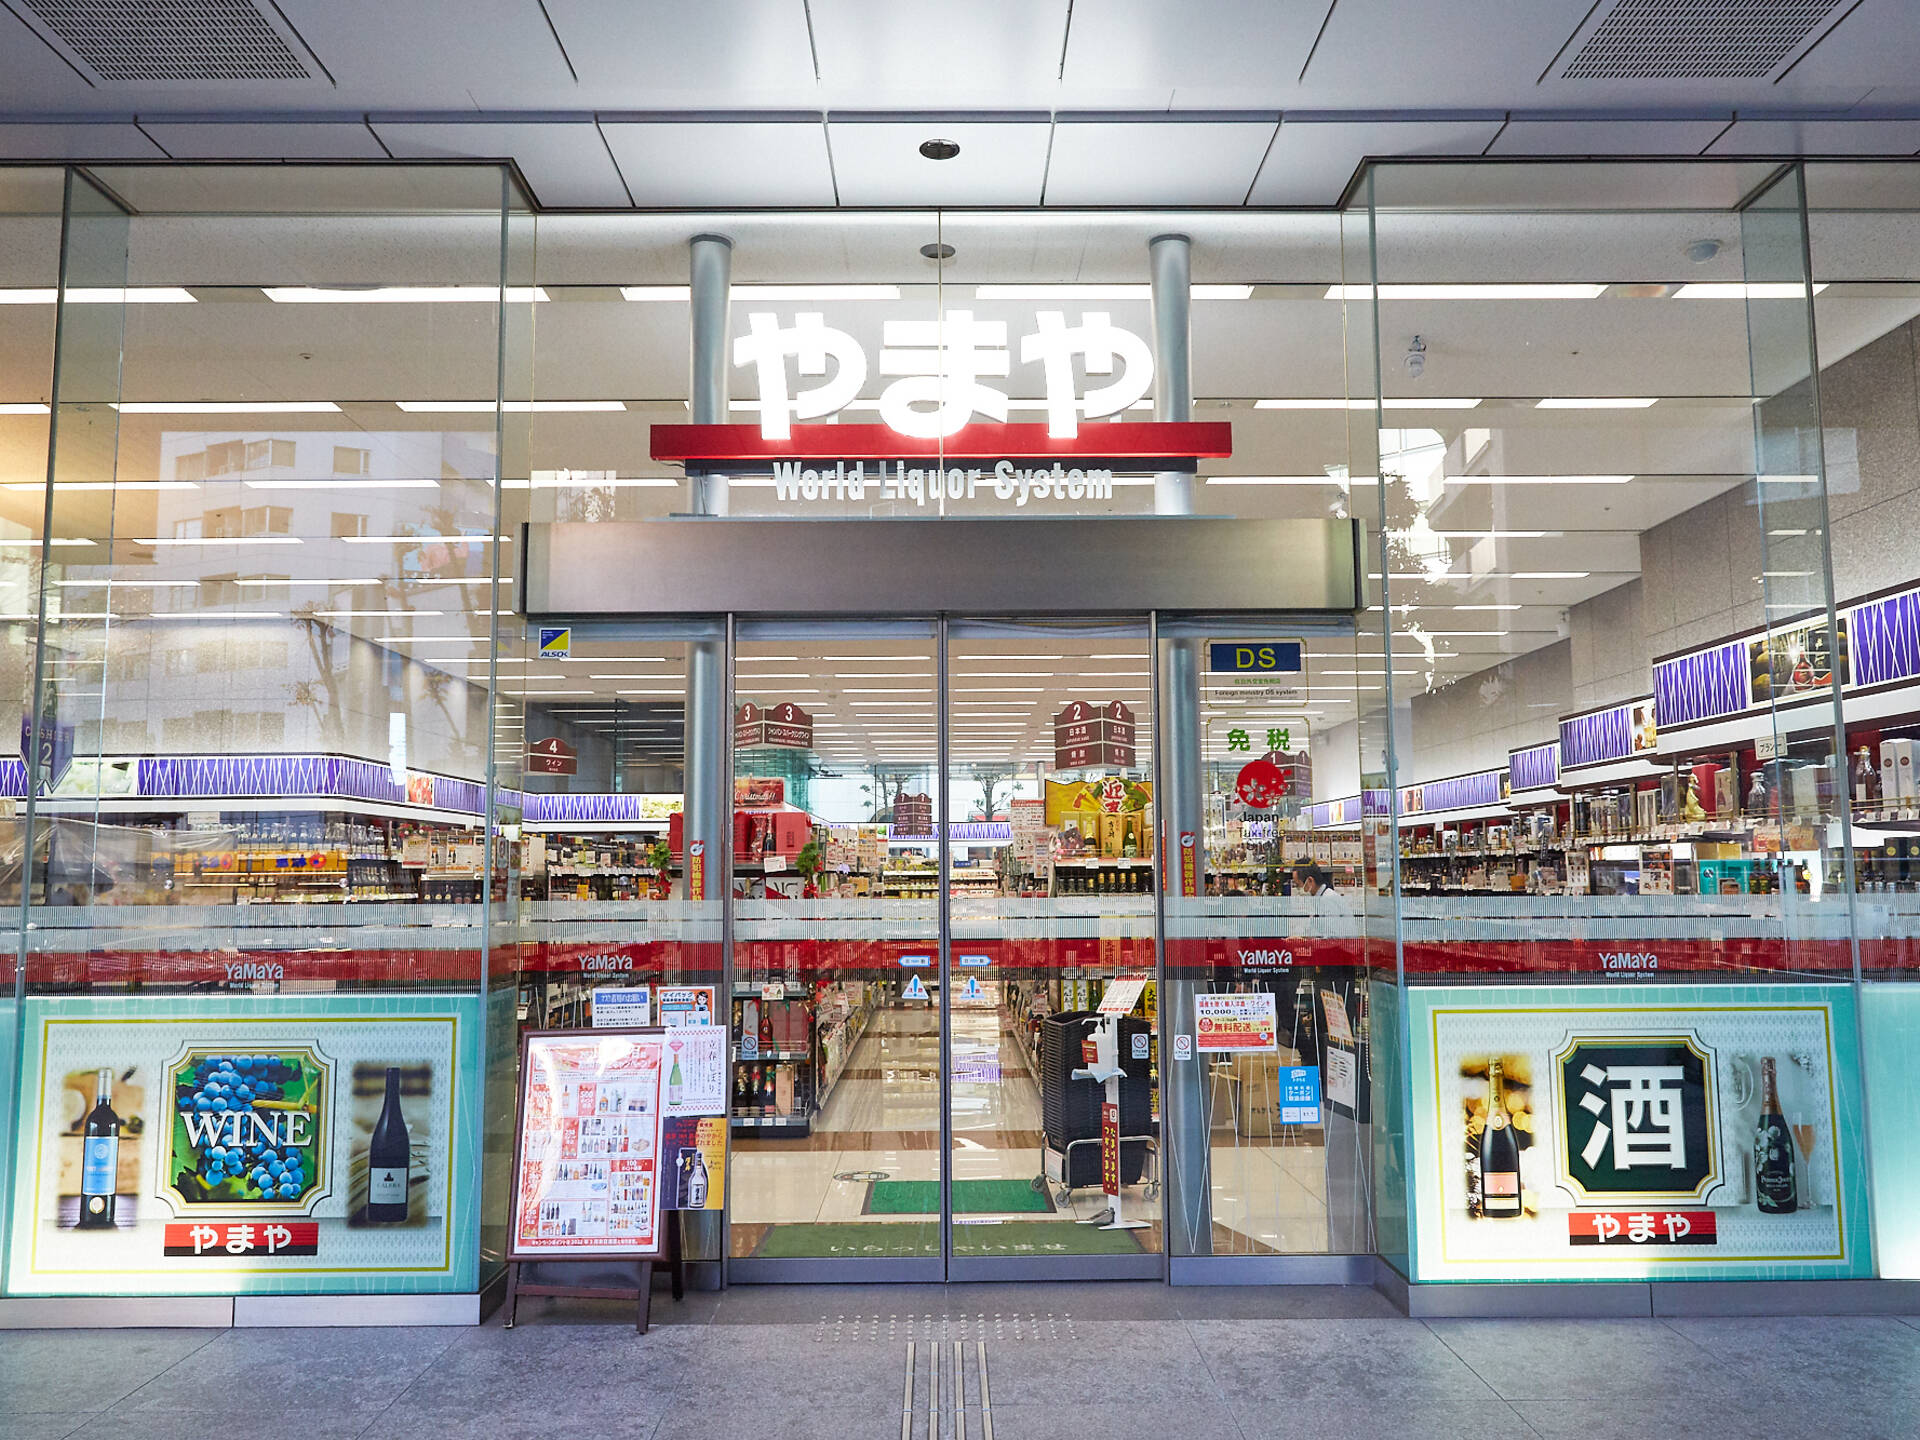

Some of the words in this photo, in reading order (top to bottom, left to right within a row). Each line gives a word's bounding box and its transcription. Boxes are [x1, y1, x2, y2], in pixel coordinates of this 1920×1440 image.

[733, 310, 1155, 440] やまや
[773, 461, 865, 501] World
[879, 460, 981, 507] Liquor
[994, 460, 1112, 506] System
[1236, 648, 1276, 668] DS
[744, 705, 751, 721] 3
[785, 705, 793, 721] 3
[1073, 704, 1081, 721] 2
[1116, 703, 1122, 719] 2
[549, 740, 558, 753] 4
[1227, 728, 1290, 751] 免税
[1759, 743, 1782, 753] ブランー
[41, 742, 52, 765] 2
[1270, 753, 1276, 764] 1
[578, 955, 633, 970] YaMaYa
[1237, 949, 1293, 965] YaMaYa
[1598, 952, 1658, 969] YaMaYa
[224, 963, 283, 980] YaMaYa
[1214, 1022, 1252, 1033] 無料配送
[1579, 1064, 1686, 1170] 酒
[181, 1111, 312, 1148] WINE
[1593, 1213, 1691, 1243] やまや
[190, 1225, 292, 1254] やまや
